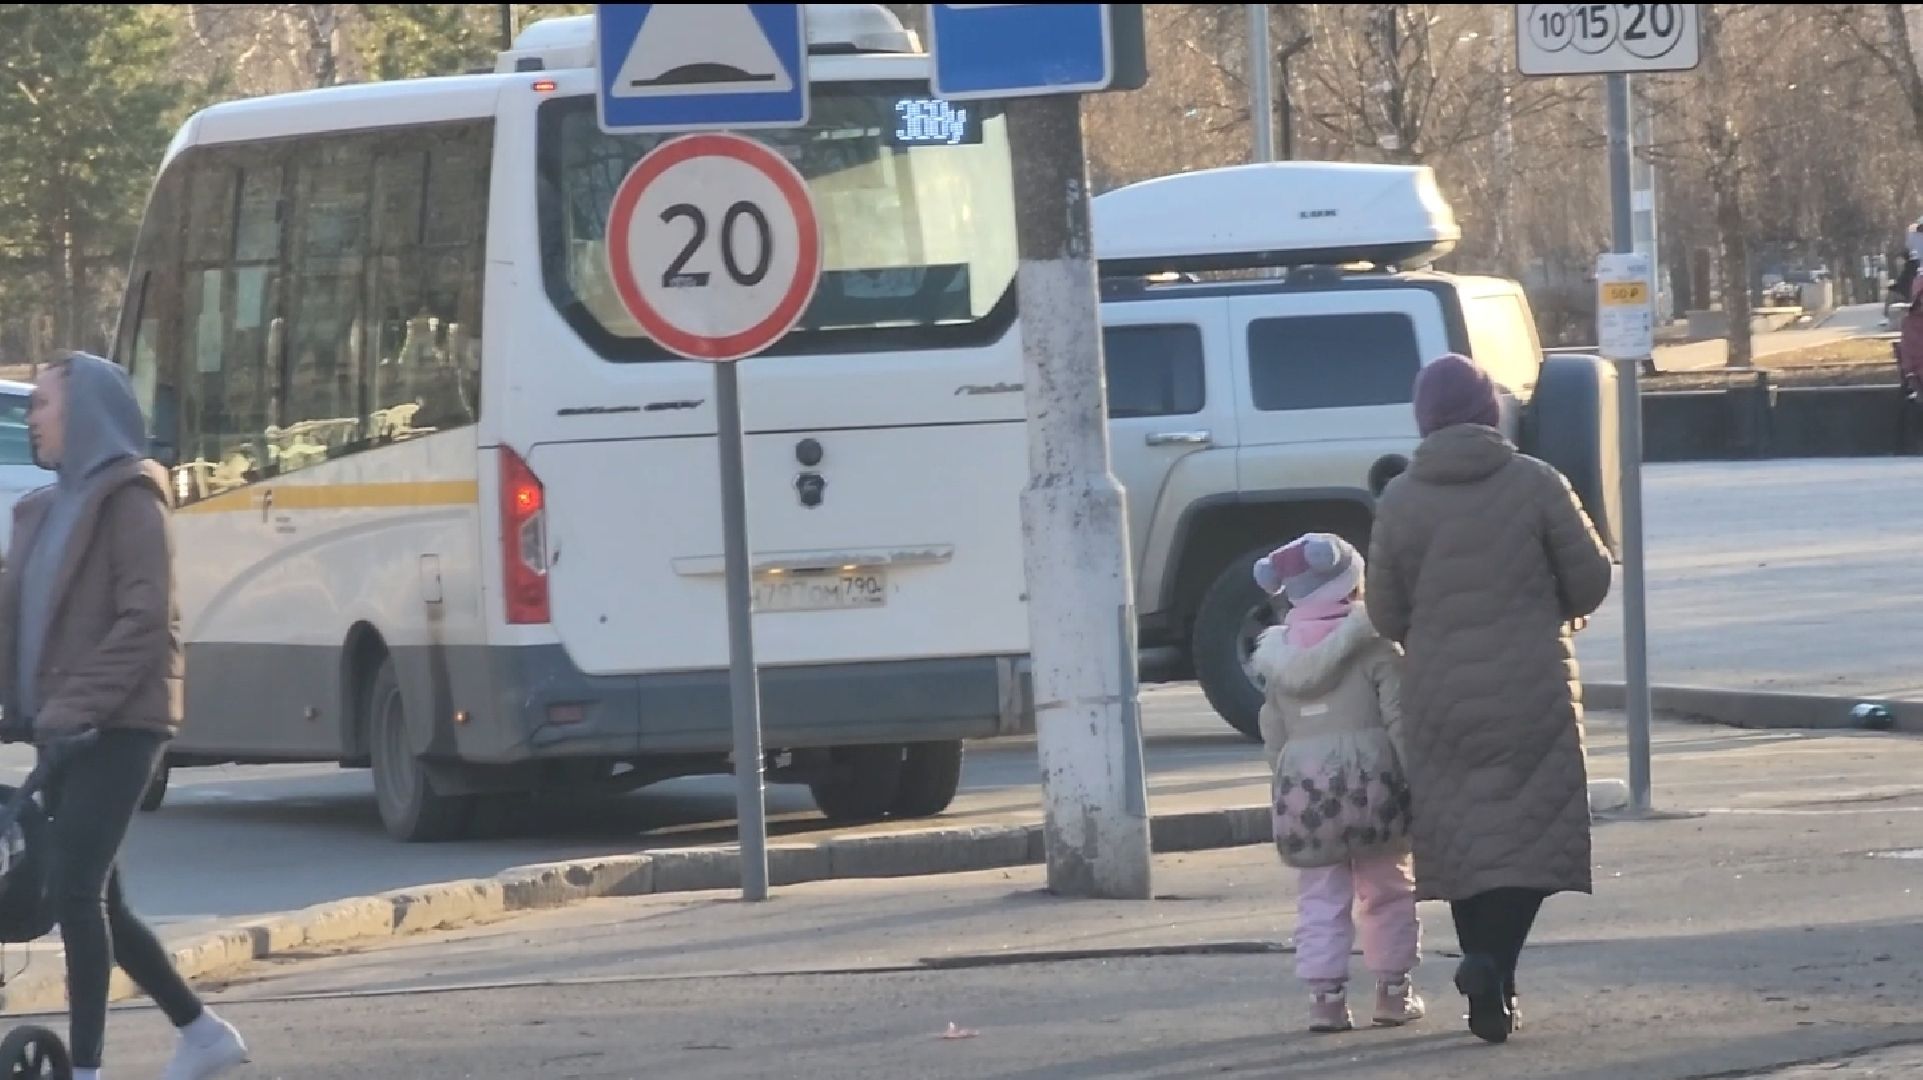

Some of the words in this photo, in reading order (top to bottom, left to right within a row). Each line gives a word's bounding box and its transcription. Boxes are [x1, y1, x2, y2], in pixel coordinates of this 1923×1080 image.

[1539, 12, 1565, 38] 10
[1575, 5, 1609, 39] 15
[1623, 4, 1675, 41] 20
[660, 200, 773, 288] 20
[843, 576, 877, 595] 790
